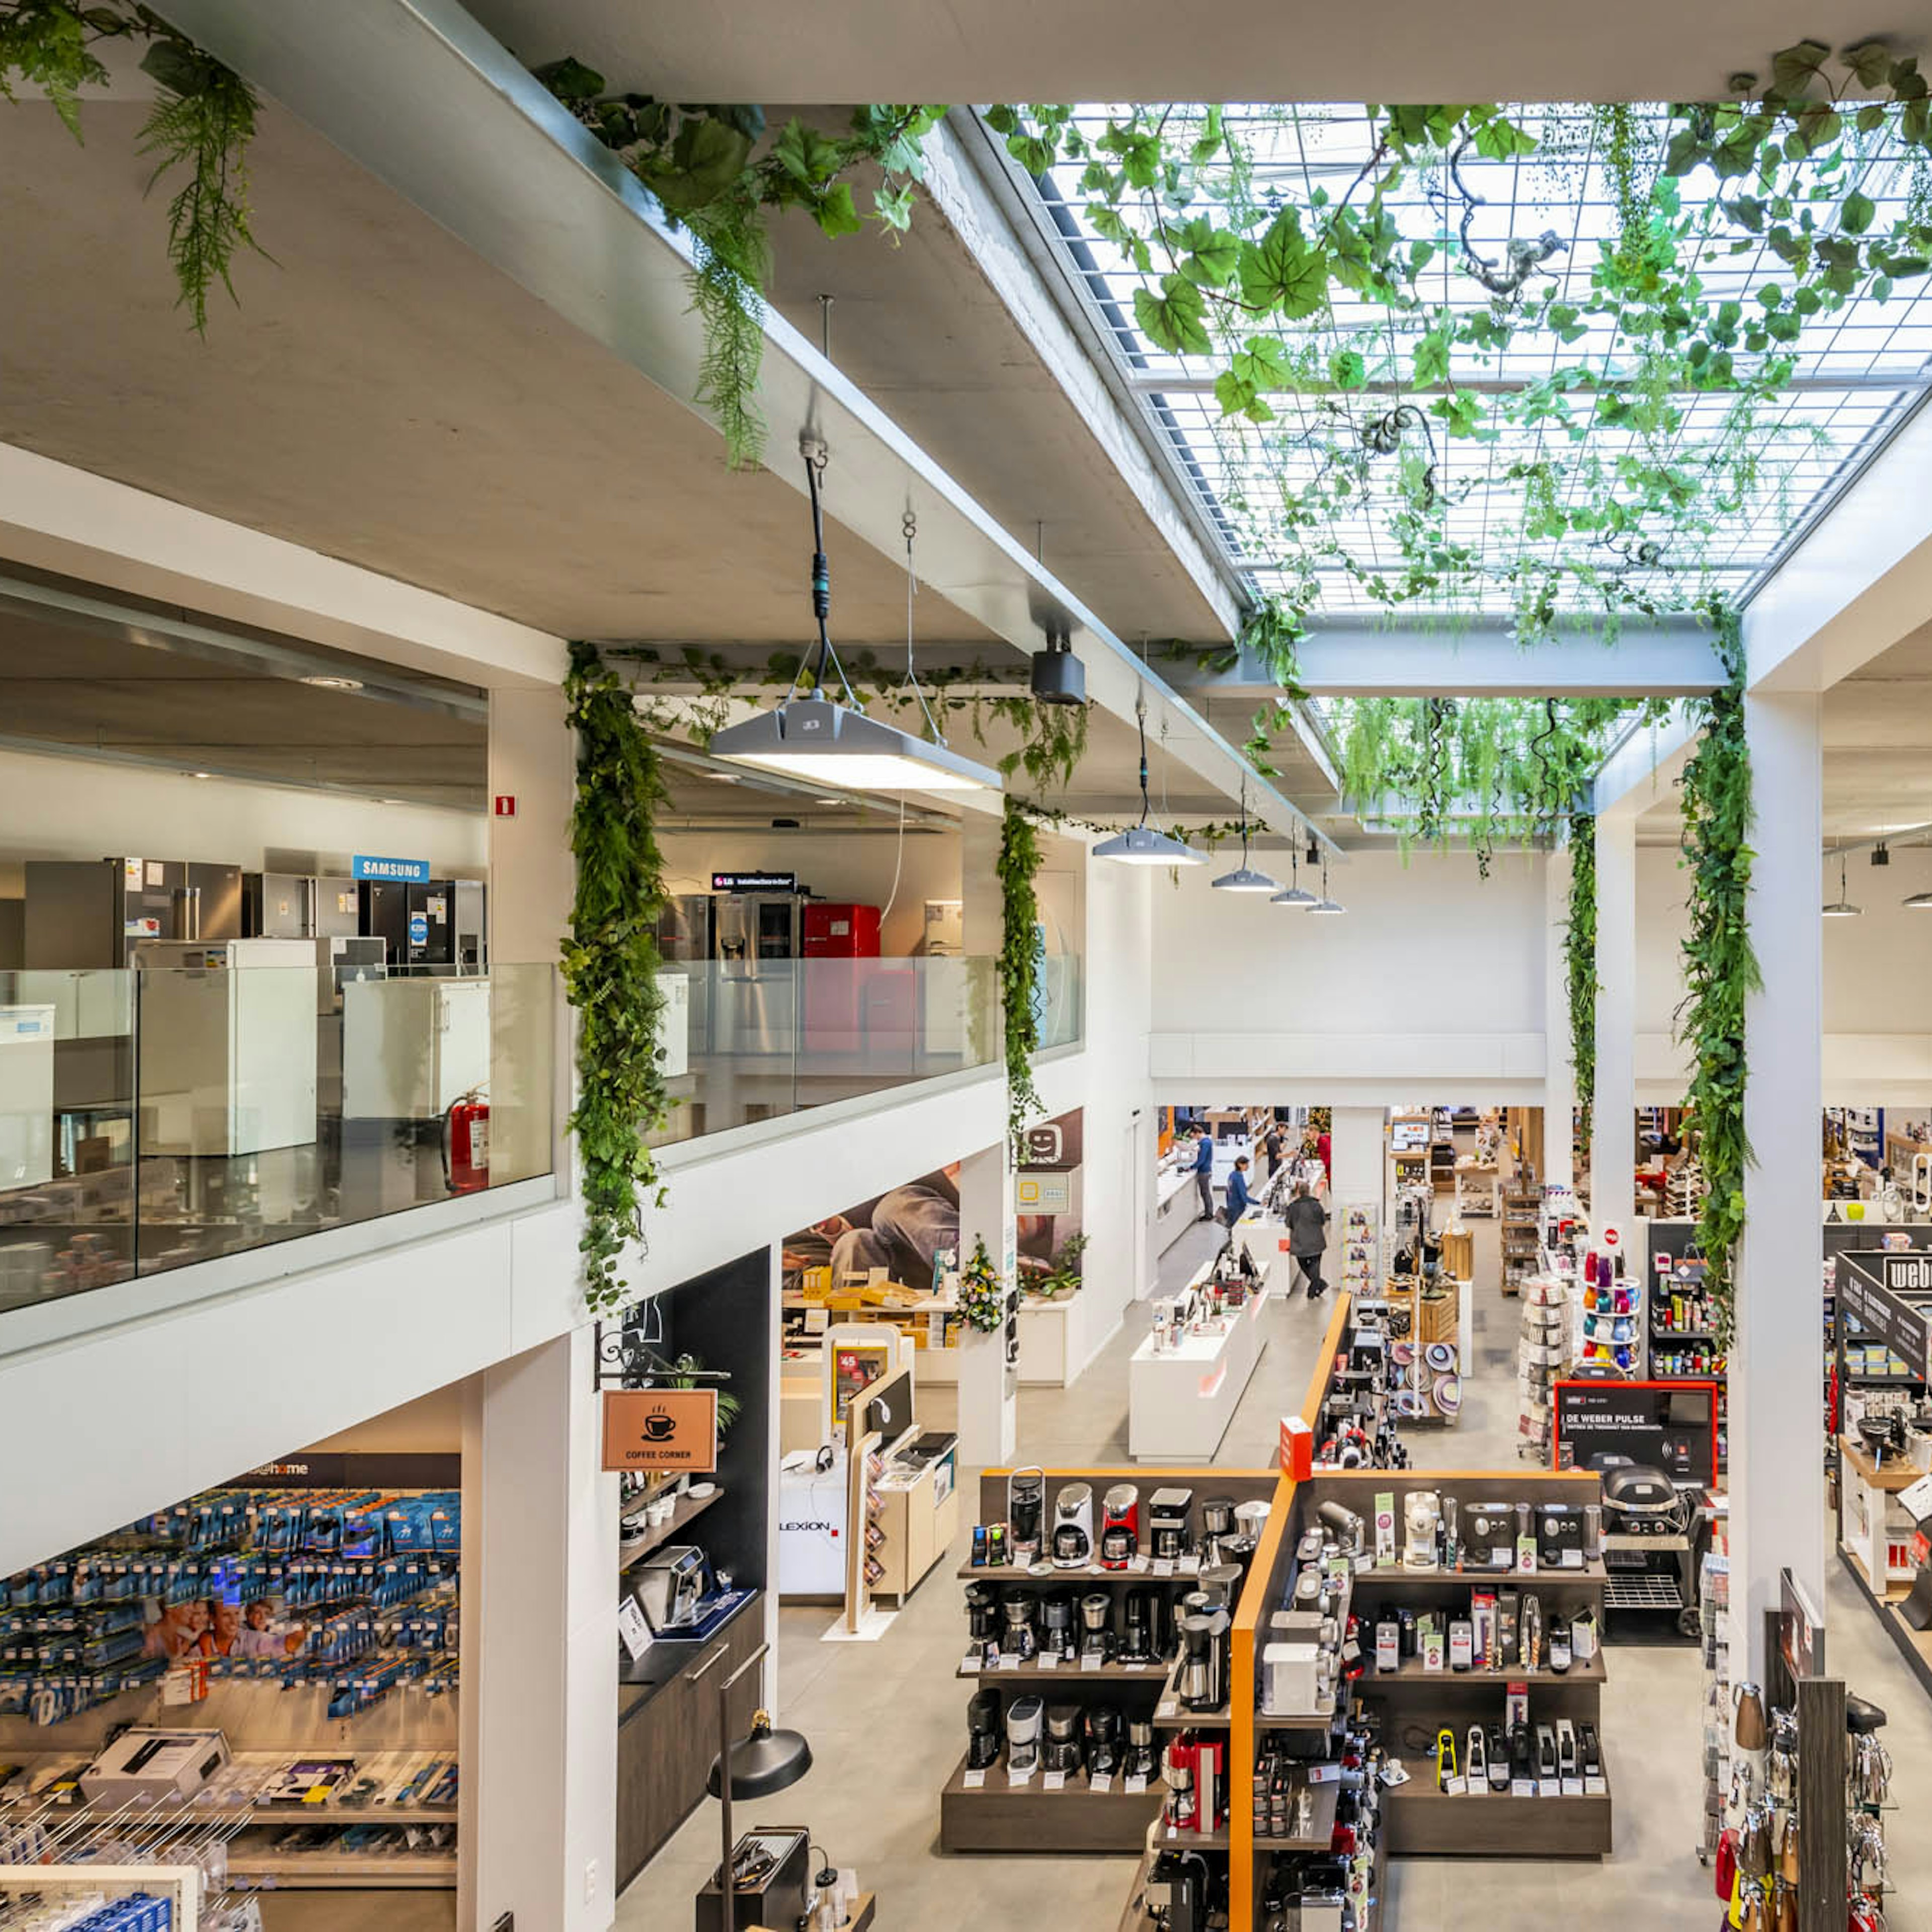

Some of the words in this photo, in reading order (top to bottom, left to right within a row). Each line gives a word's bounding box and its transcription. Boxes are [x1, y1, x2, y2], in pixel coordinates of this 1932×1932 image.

[363, 861, 420, 877] SAMSUNG
[1890, 1258, 1932, 1288] web
[1567, 1414, 1578, 1423] DE
[1581, 1414, 1613, 1423] WEBER
[1615, 1415, 1645, 1423] PULSE
[626, 1451, 656, 1459] COFFEE
[659, 1451, 691, 1459] CORNER
